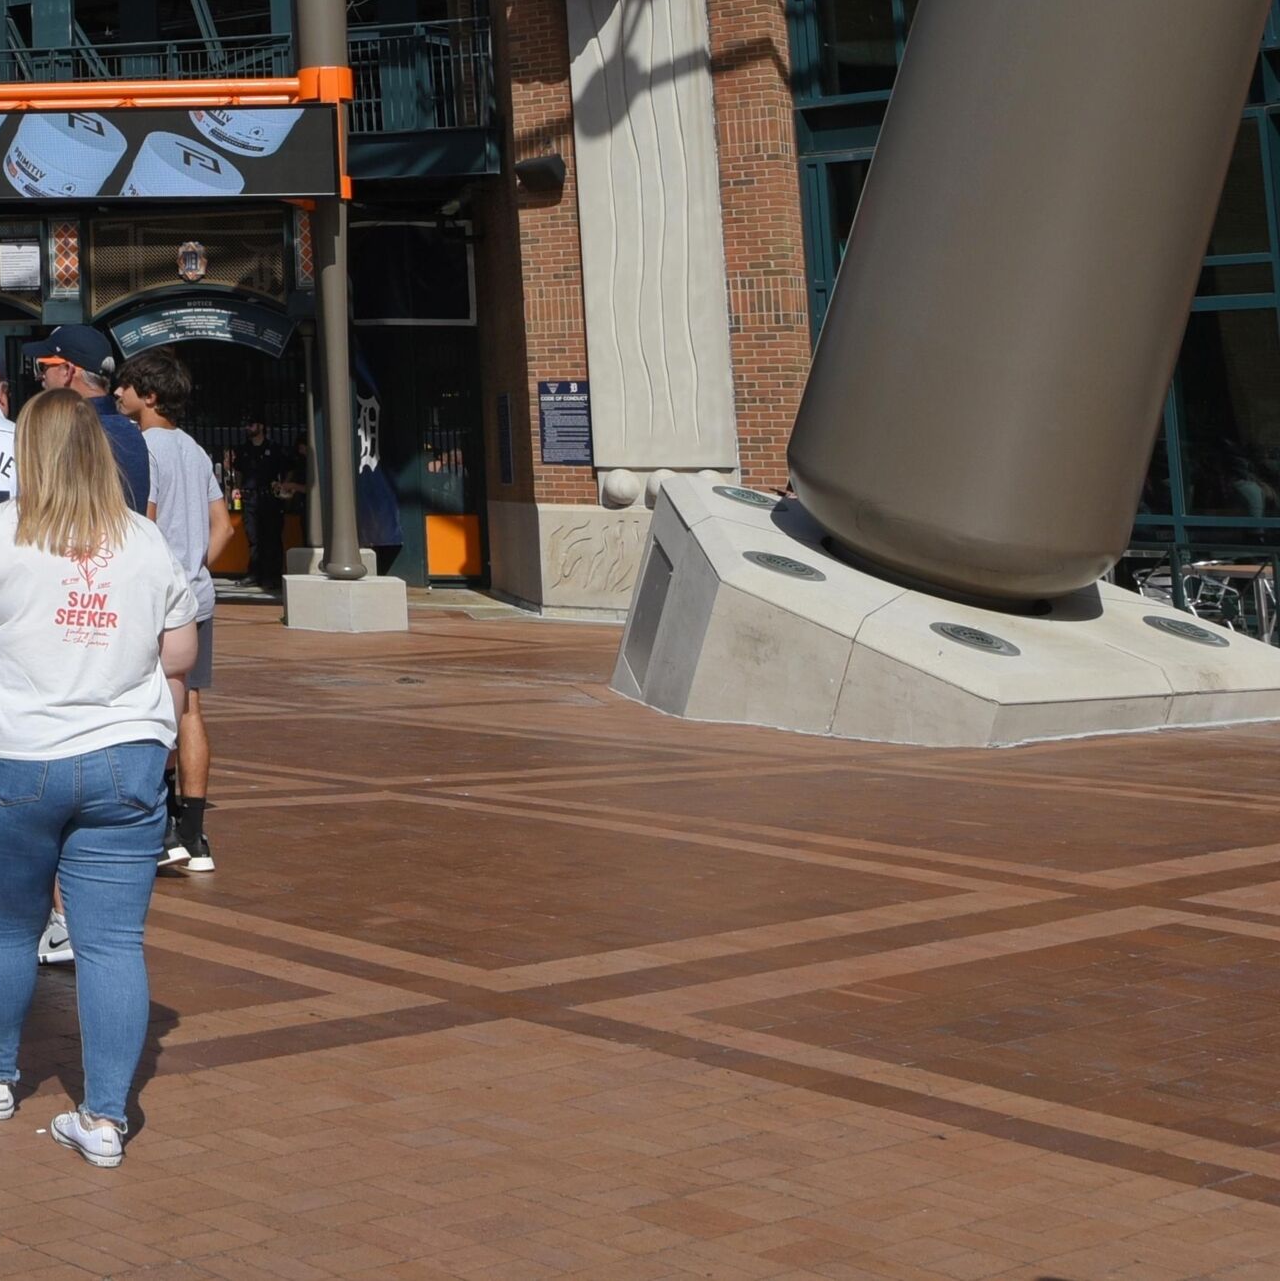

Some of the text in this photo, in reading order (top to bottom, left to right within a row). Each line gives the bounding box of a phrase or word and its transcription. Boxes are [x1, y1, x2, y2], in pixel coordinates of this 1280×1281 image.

[13, 146, 47, 183] PRIMITIV
[67, 591, 108, 610] SUN
[54, 608, 118, 628] SEEKER
